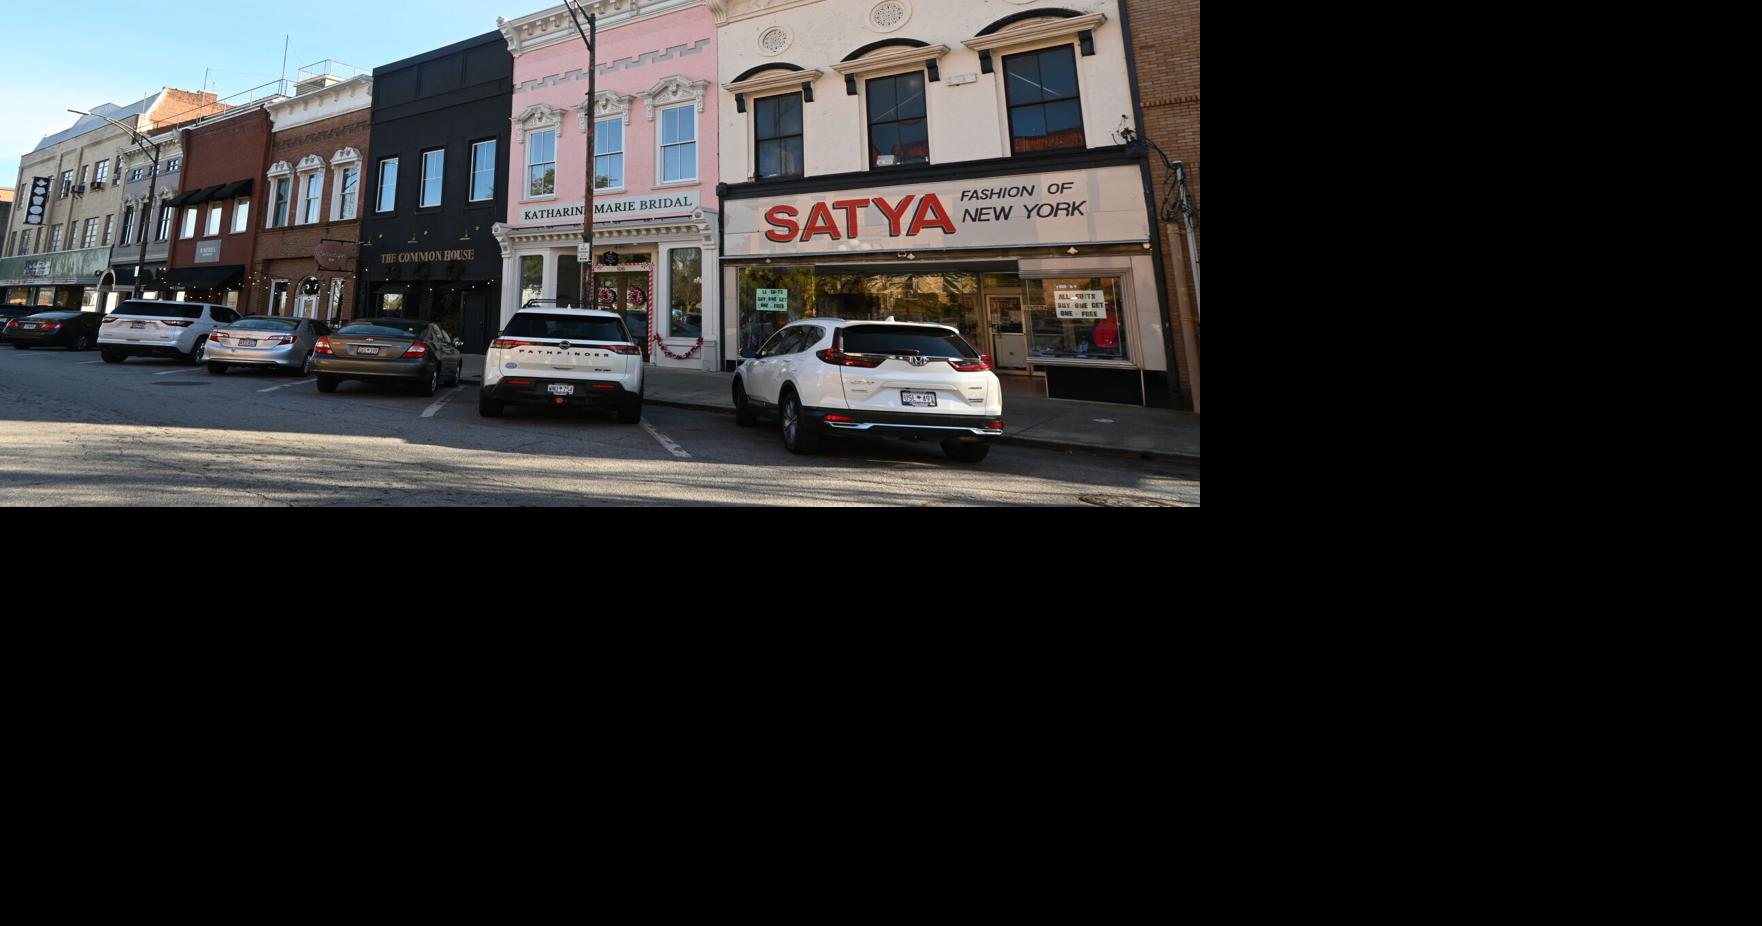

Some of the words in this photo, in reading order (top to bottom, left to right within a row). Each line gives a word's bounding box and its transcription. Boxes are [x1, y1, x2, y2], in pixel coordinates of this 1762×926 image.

[960, 185, 1035, 202] FASHION
[1047, 181, 1074, 195] OF
[524, 204, 585, 220] KATHARIN
[594, 201, 636, 214] MARIE
[639, 196, 693, 211] BRIDAL
[764, 193, 956, 243] SATYA
[962, 205, 1013, 223] NEW
[1023, 200, 1087, 219] YORK
[380, 253, 397, 264] THE
[398, 250, 442, 263] COMMON
[443, 248, 475, 261] HOUSE
[519, 349, 609, 357] PATHFINDER
